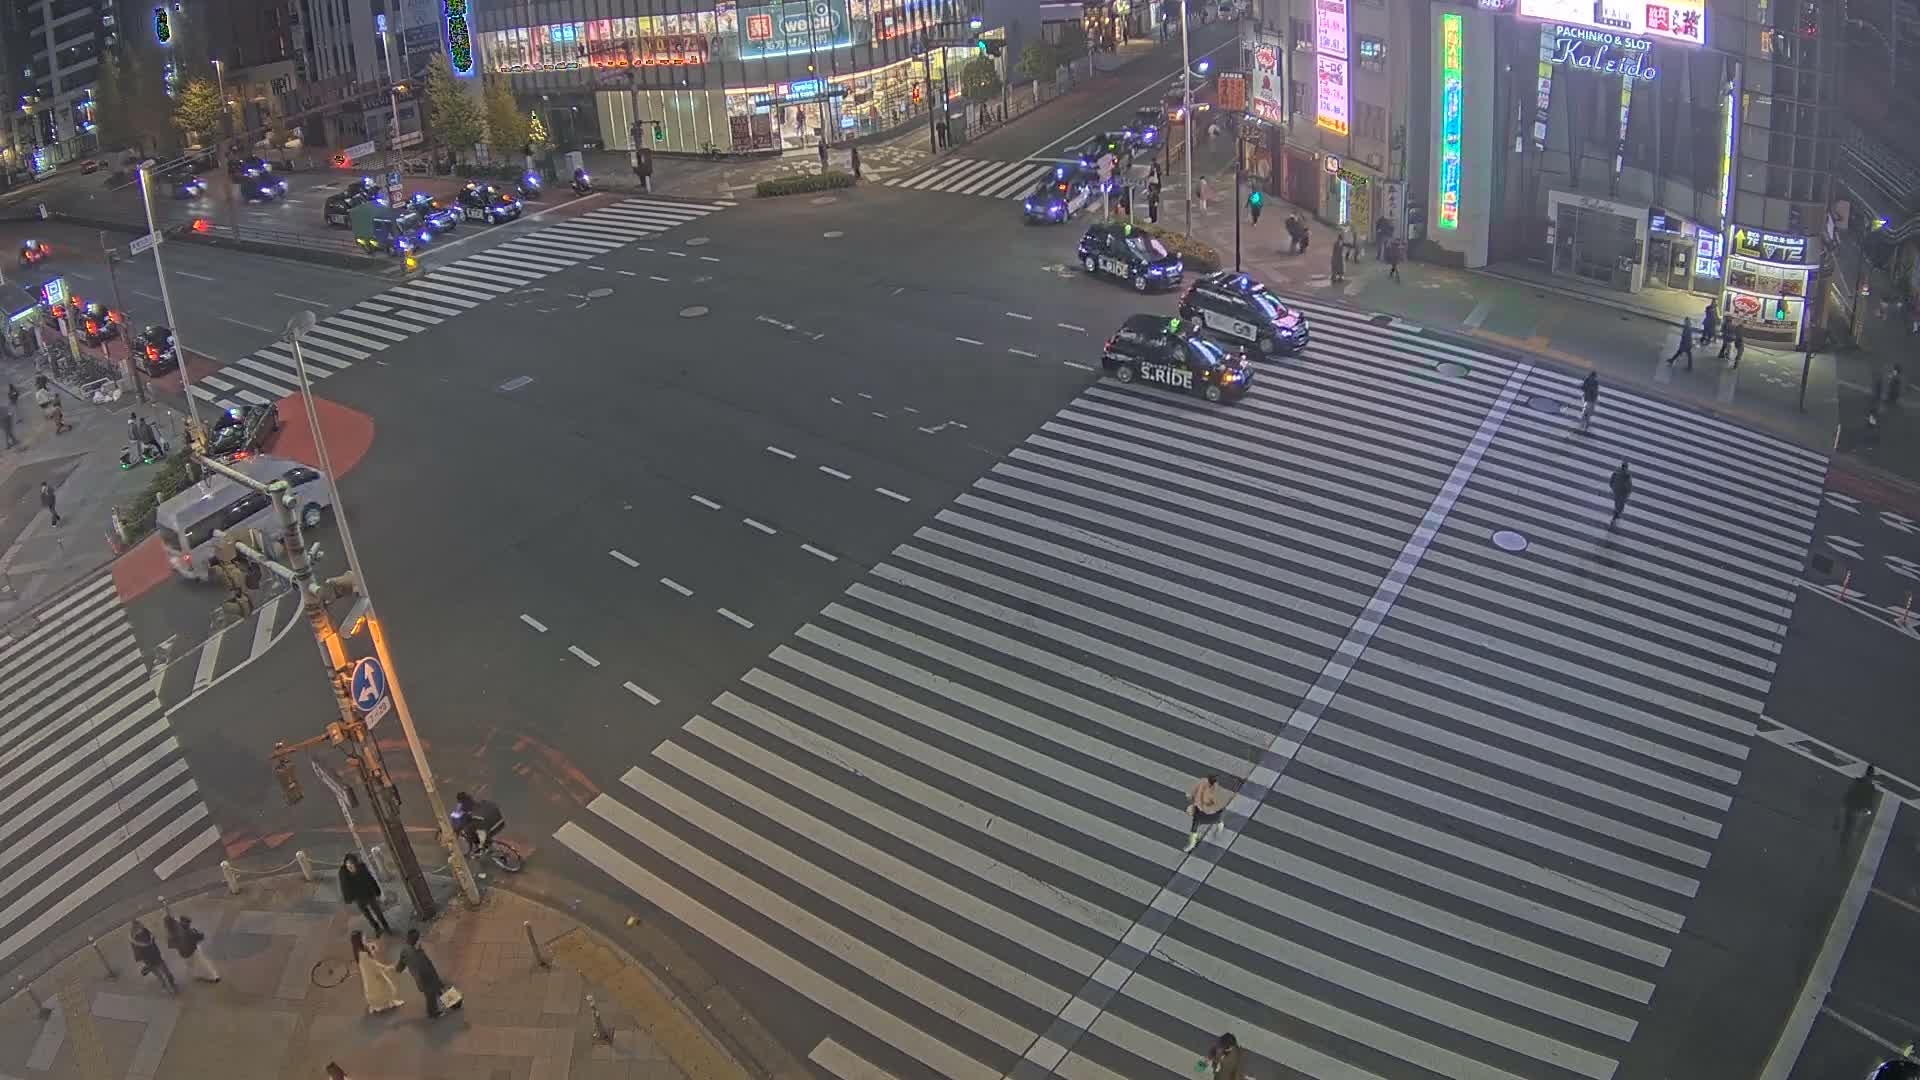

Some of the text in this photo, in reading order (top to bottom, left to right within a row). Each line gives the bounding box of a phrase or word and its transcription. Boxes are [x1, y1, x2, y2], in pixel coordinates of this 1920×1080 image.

[1556, 26, 1652, 50] PACHINKO & SLOT
[1551, 38, 1656, 80] Kaleido
[1141, 367, 1193, 390] S.RIDE
